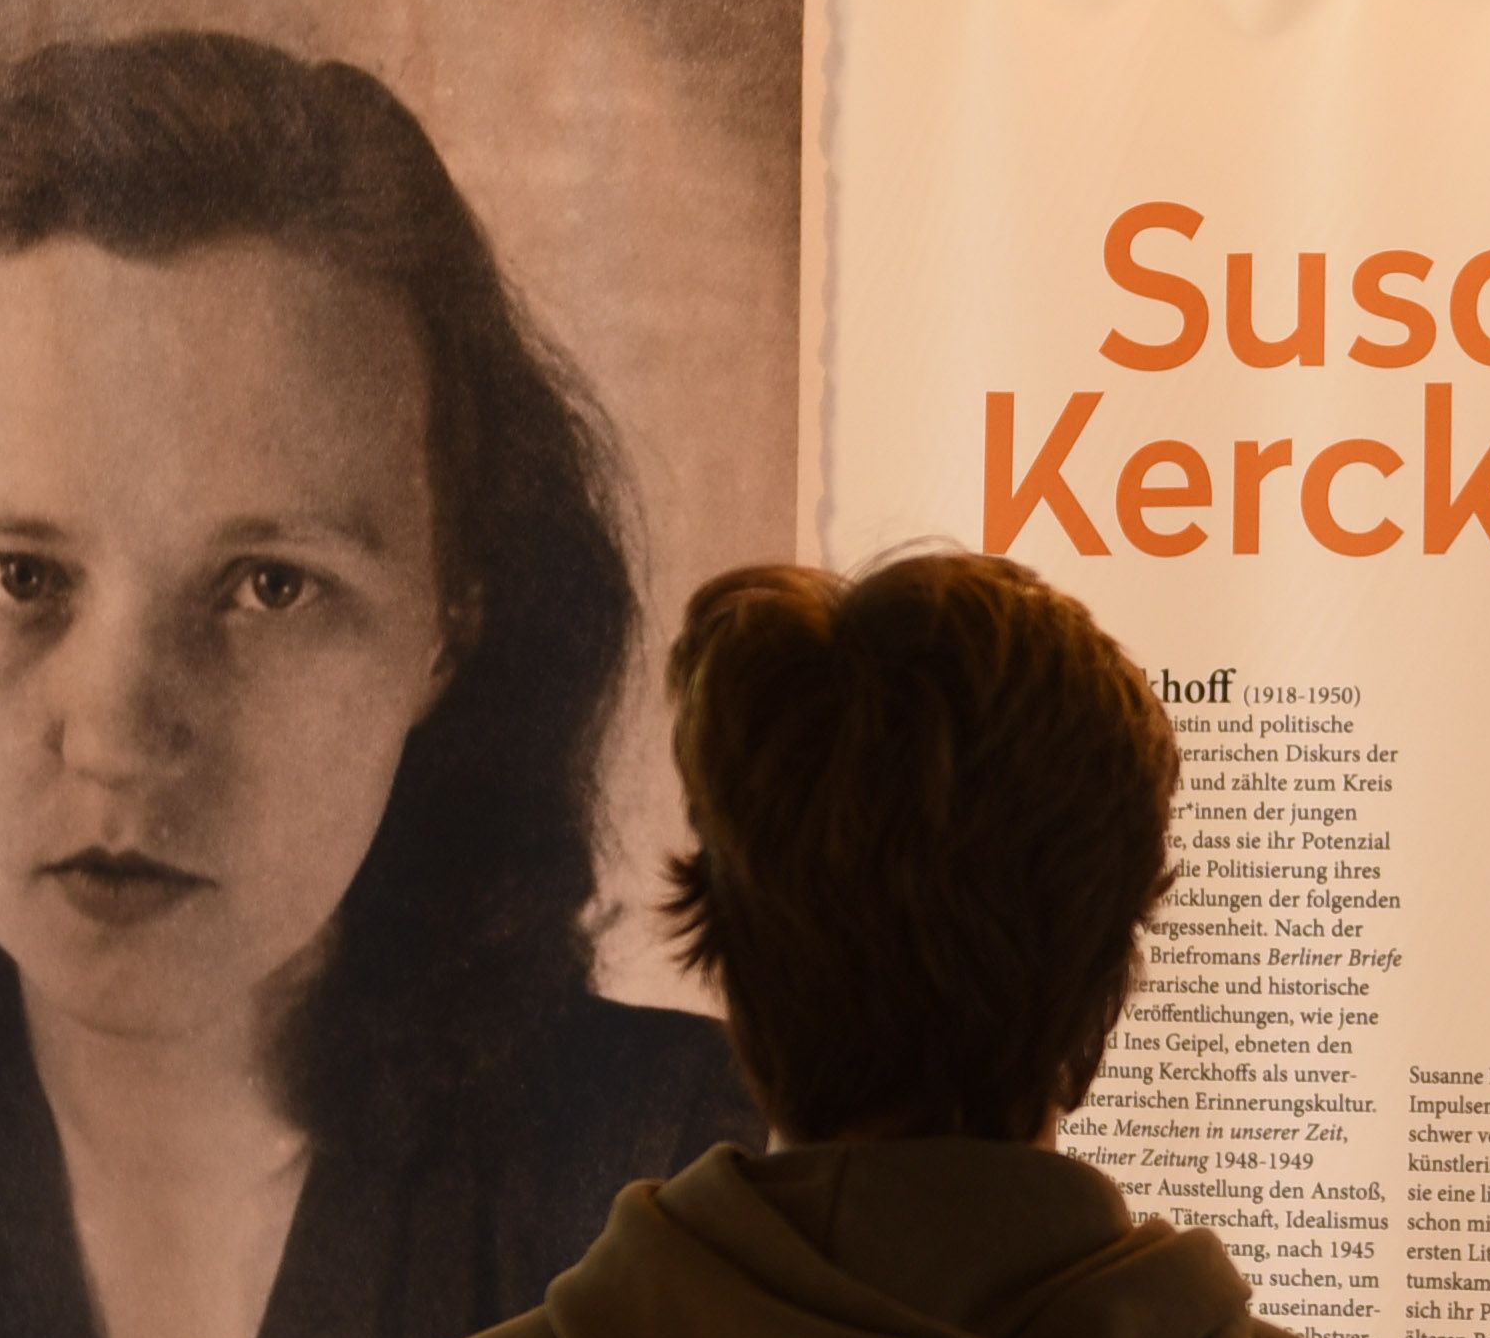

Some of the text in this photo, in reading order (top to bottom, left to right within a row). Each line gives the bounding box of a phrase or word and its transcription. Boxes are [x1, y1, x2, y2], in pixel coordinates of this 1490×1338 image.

[1244, 685, 1360, 707] (1918-1950)
[1191, 772, 1392, 791] und zählte zum Kreis
[1193, 830, 1390, 850] dass sie ihr Potenzial
[1207, 859, 1327, 885] Politisierung
[1334, 860, 1380, 879] ihres
[1275, 918, 1325, 937] Nach
[1332, 919, 1363, 937] der
[1151, 945, 1402, 972] Briefromans Berliner Briefe
[1122, 1000, 1378, 1030] Veröffentlichungen, wie jene
[1125, 1033, 1352, 1057] Ines Geipel, ebneten den
[1160, 1062, 1356, 1083] Kerckhoffs als unver-
[1410, 1066, 1483, 1085] Susanne
[1195, 1092, 1376, 1117] Erinnerungskultur.
[1057, 1114, 1347, 1143] Reihe Menschen in unserer Zeit,
[1409, 1124, 1472, 1143] schwer
[1141, 1148, 1209, 1174] Zeitung
[1216, 1152, 1313, 1170] 1948-1949
[1158, 1178, 1385, 1204] Ausstellung den Anstoß,
[1171, 1208, 1388, 1232] Täterschaft, Idealismus
[1259, 1299, 1380, 1319] auseinander-
